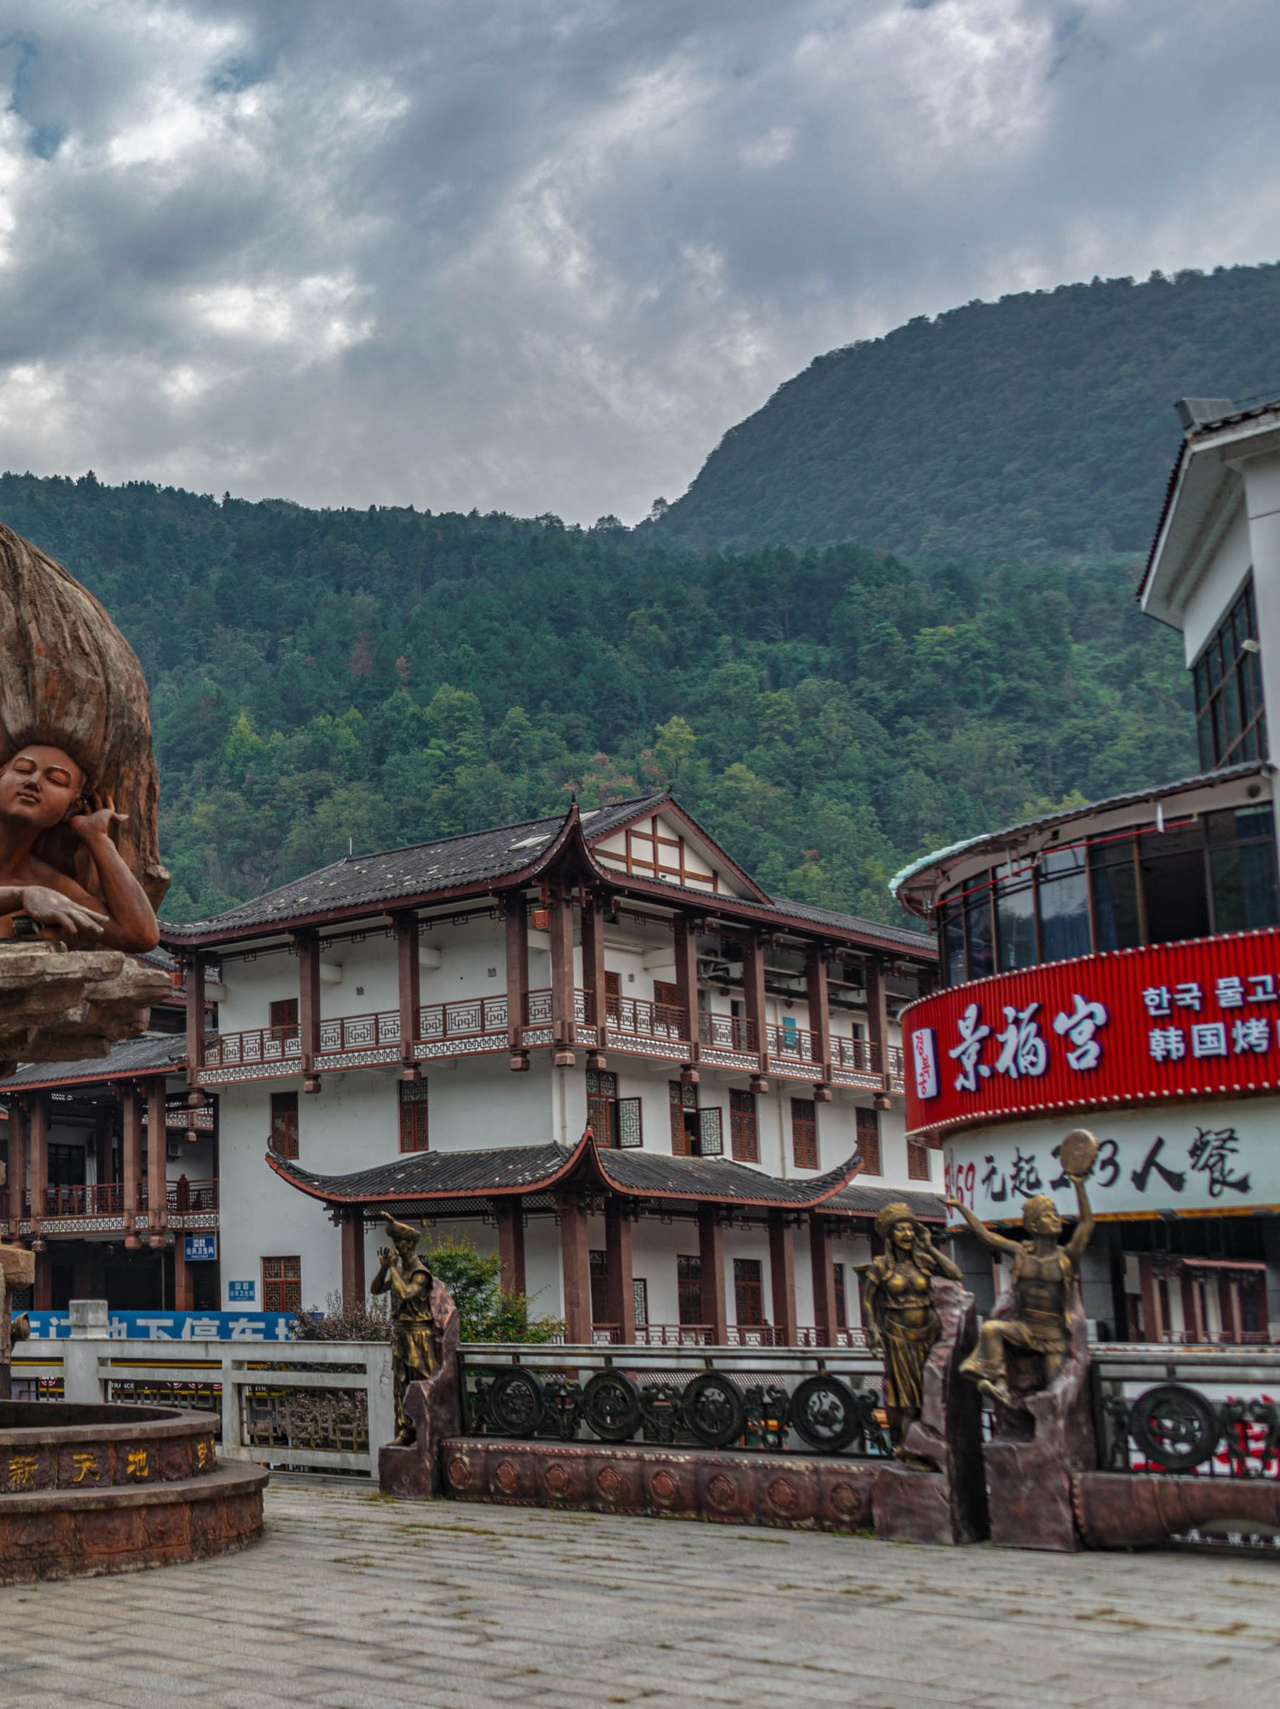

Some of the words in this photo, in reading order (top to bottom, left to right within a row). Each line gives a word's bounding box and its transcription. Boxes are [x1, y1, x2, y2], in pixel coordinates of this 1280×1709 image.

[1142, 986, 1202, 1016] 한국
[1215, 975, 1280, 1008] 물고
[949, 994, 1107, 1093] 景福宫
[1148, 1018, 1280, 1062] 韩国烤
